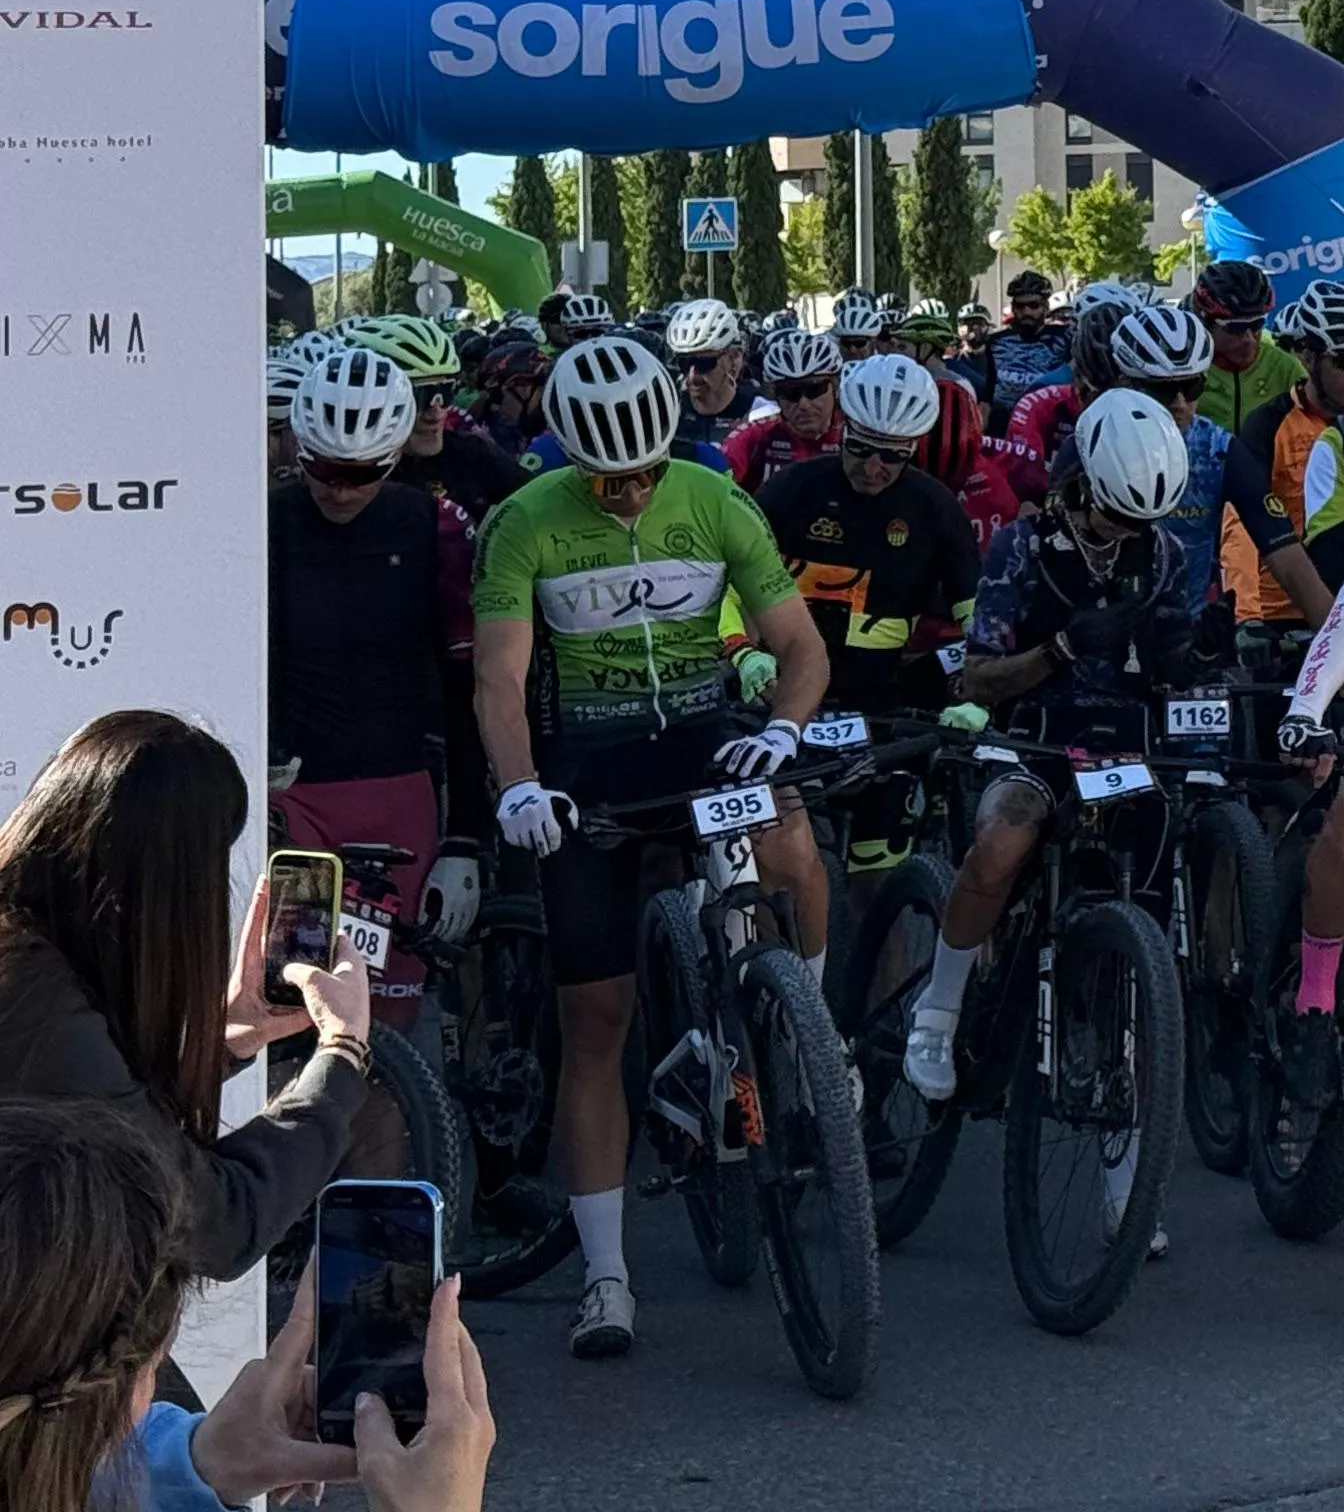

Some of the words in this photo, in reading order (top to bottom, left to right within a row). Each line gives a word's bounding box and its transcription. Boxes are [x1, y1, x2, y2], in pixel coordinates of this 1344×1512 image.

[0, 11, 153, 29] VIDAL
[37, 136, 99, 149] Huesca
[107, 134, 153, 148] hotel
[1172, 706, 1228, 727] 1162
[810, 722, 855, 741] 537
[1104, 772, 1123, 788] 9
[707, 792, 763, 824] 395
